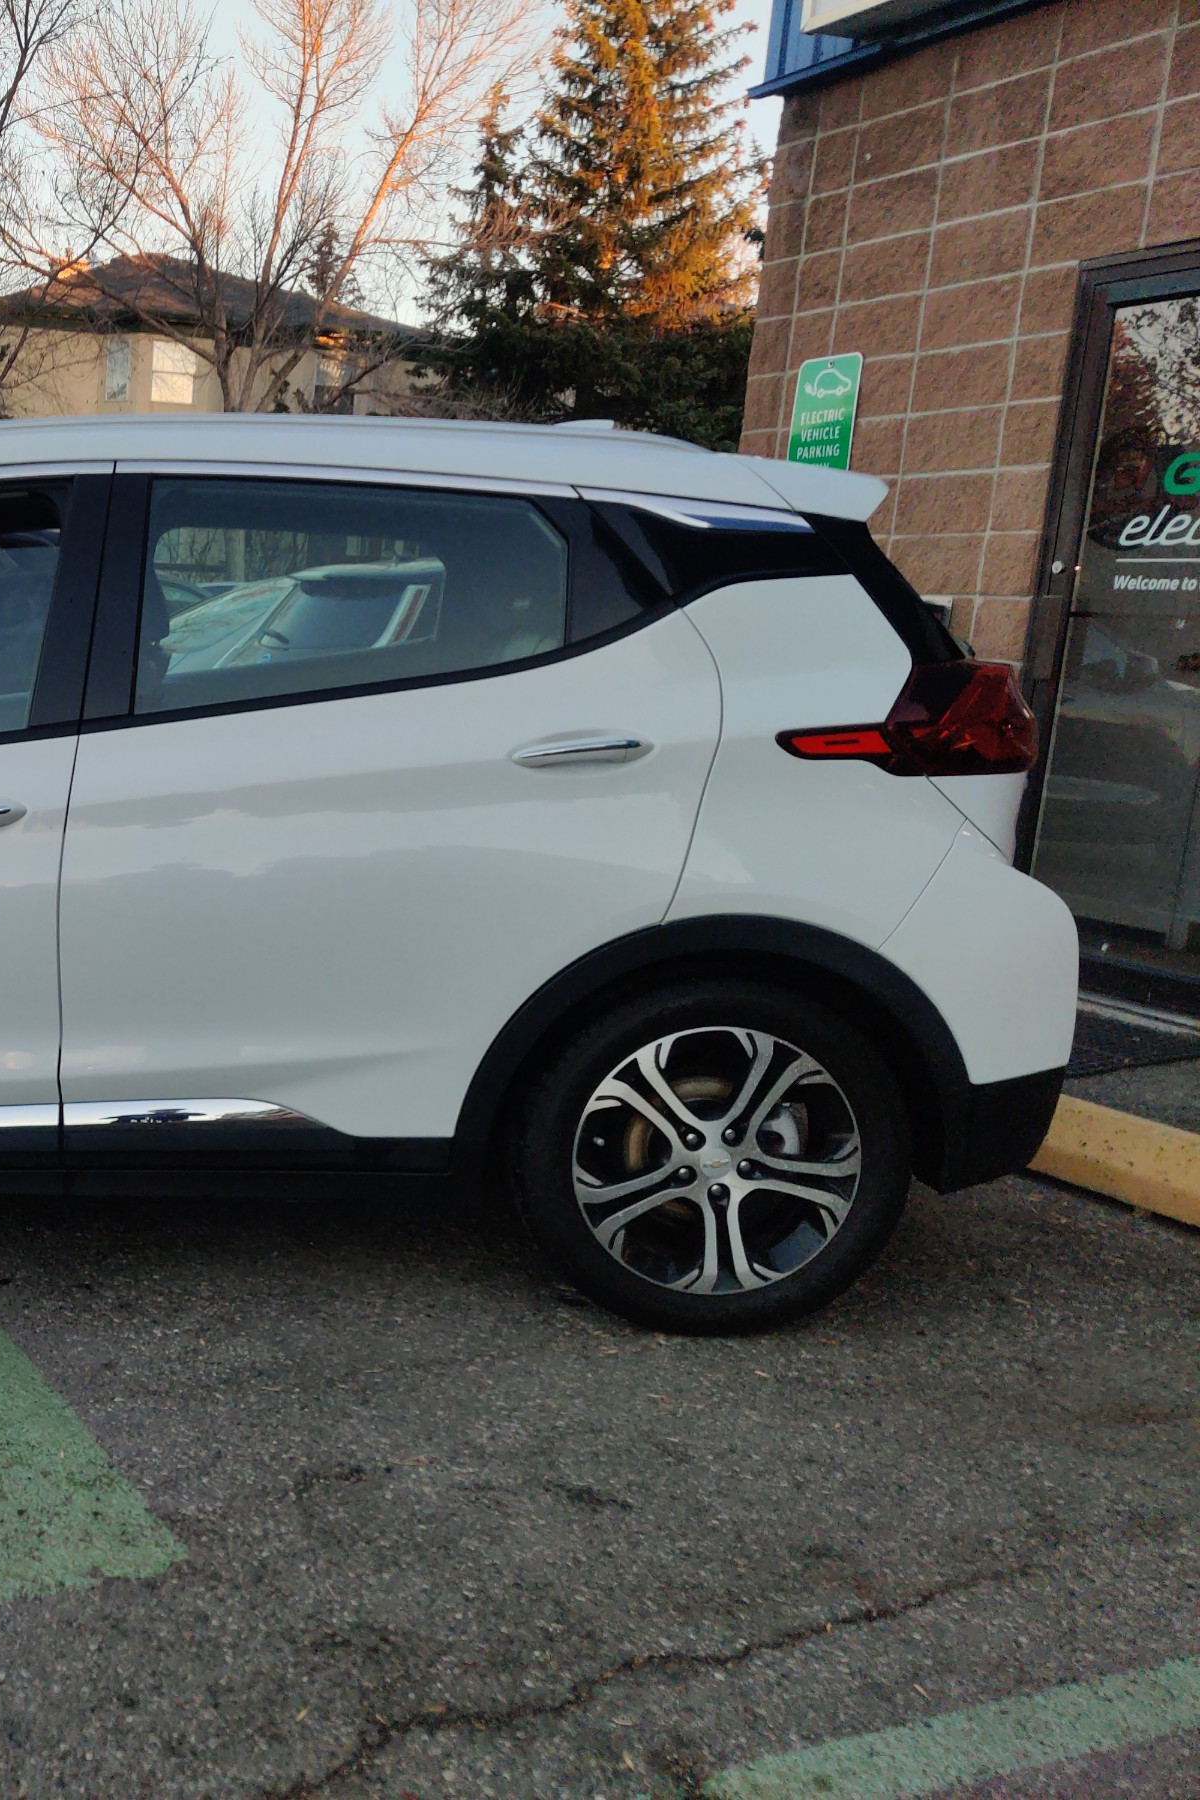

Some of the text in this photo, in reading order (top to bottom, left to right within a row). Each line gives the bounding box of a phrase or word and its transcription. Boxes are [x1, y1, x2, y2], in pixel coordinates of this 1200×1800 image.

[801, 408, 846, 426] ELECTRIC
[801, 426, 841, 442] VEHICLE
[796, 443, 841, 460] PARKING
[1113, 574, 1180, 591] Welcome
[1181, 576, 1197, 591] to
